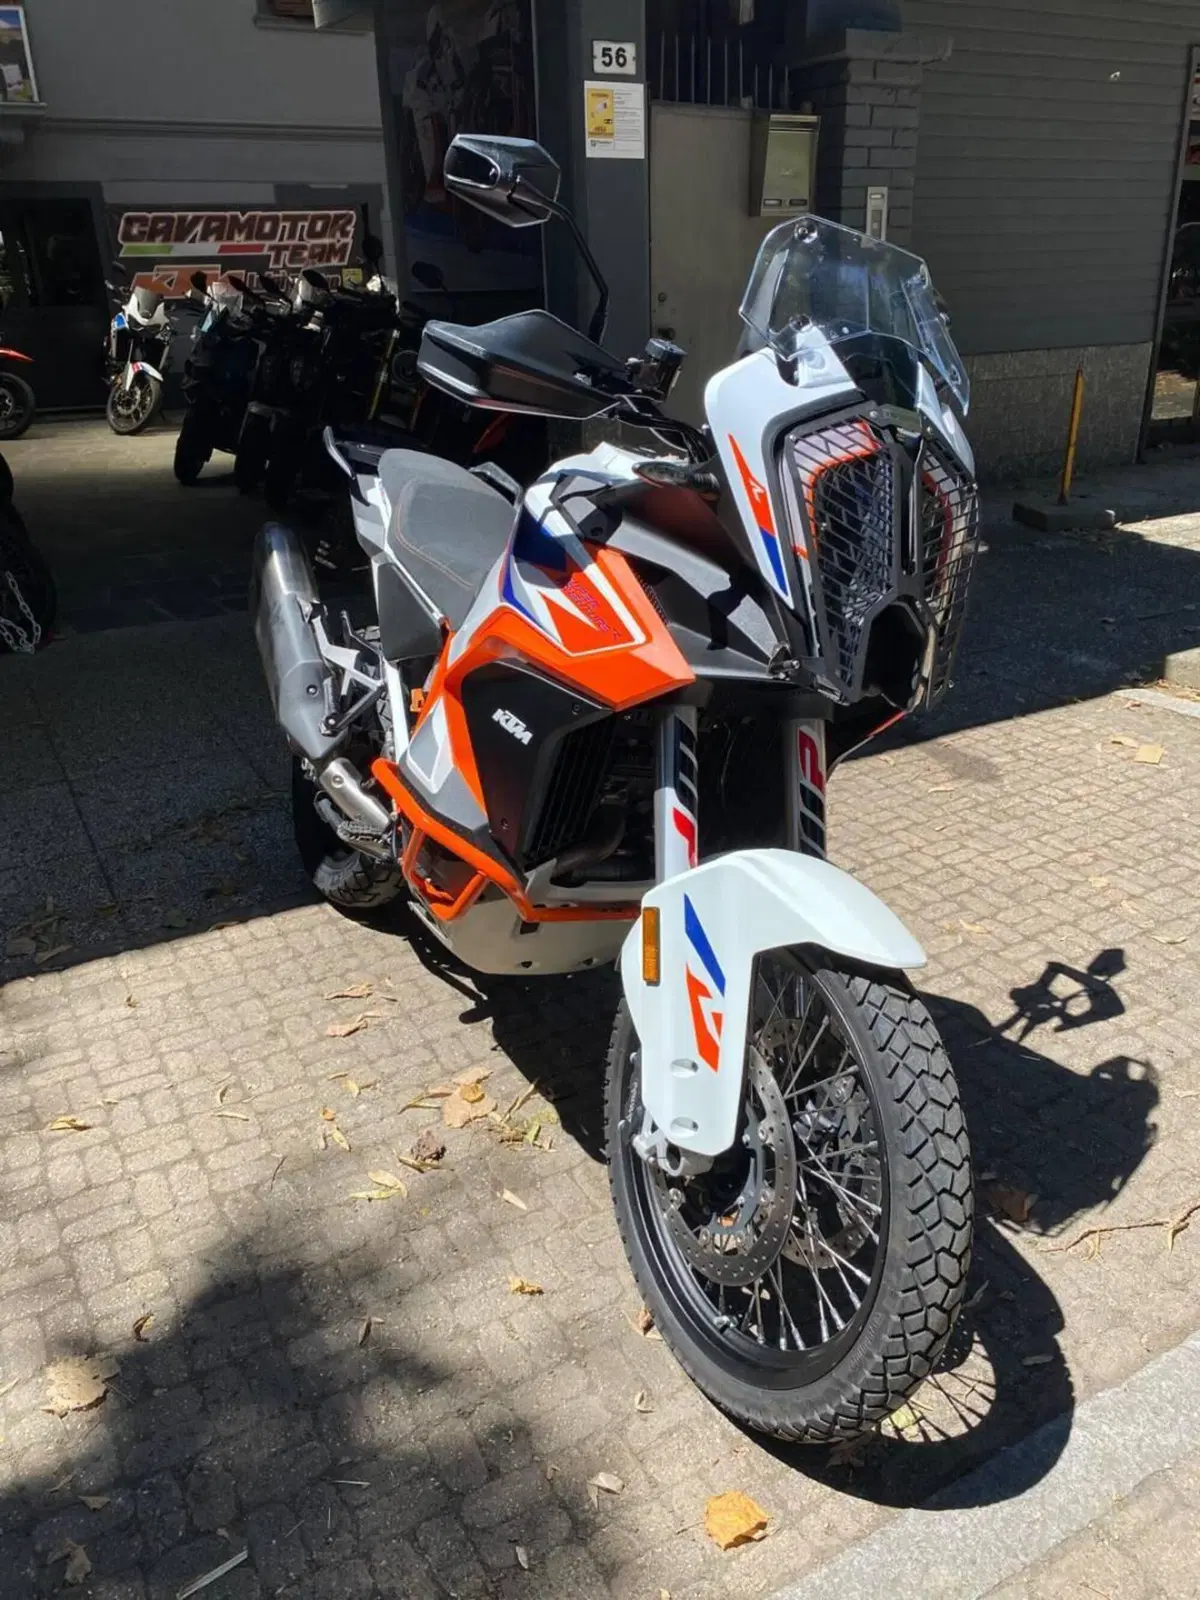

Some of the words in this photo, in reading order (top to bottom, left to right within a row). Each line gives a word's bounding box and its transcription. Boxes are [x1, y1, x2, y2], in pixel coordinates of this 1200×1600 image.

[601, 46, 627, 68] 56
[264, 242, 353, 268] TEAM
[491, 708, 533, 745] KTM
